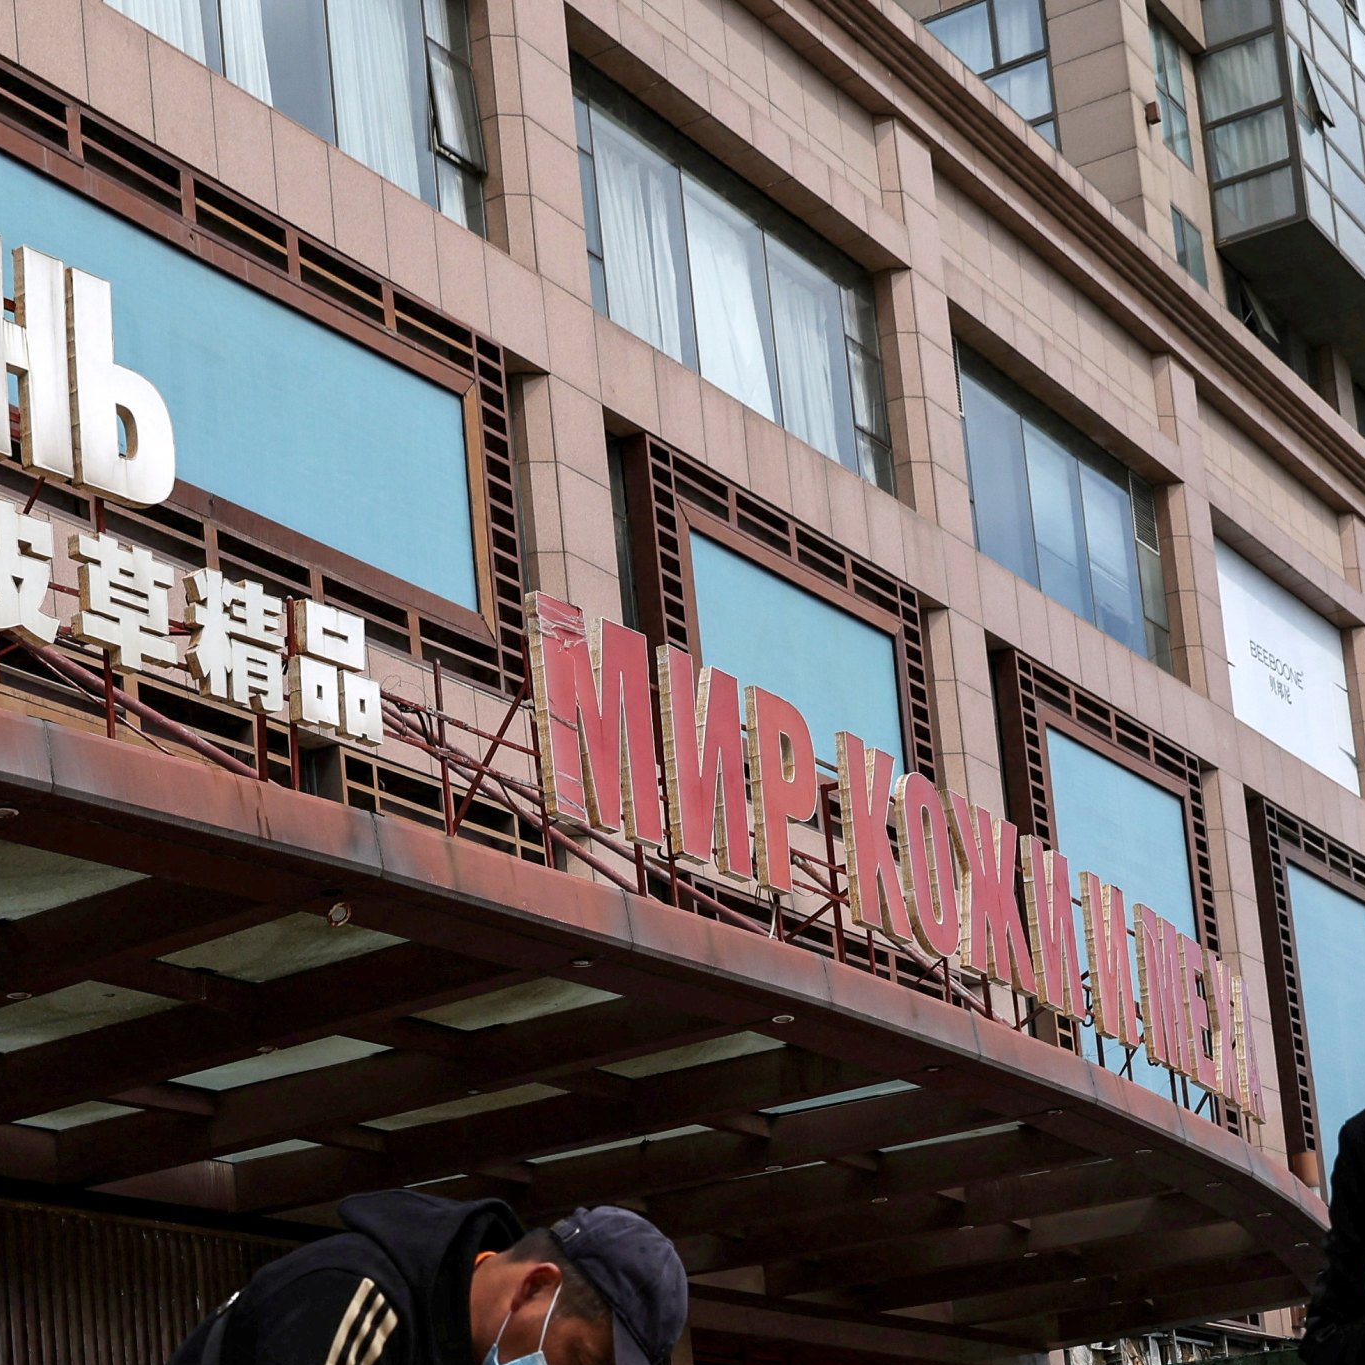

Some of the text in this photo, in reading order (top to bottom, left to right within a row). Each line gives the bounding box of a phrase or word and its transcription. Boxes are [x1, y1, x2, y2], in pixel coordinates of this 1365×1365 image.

[525, 590, 816, 895] МИР
[836, 730, 1087, 1022] КОЖИ
[1079, 870, 1140, 1048] И
